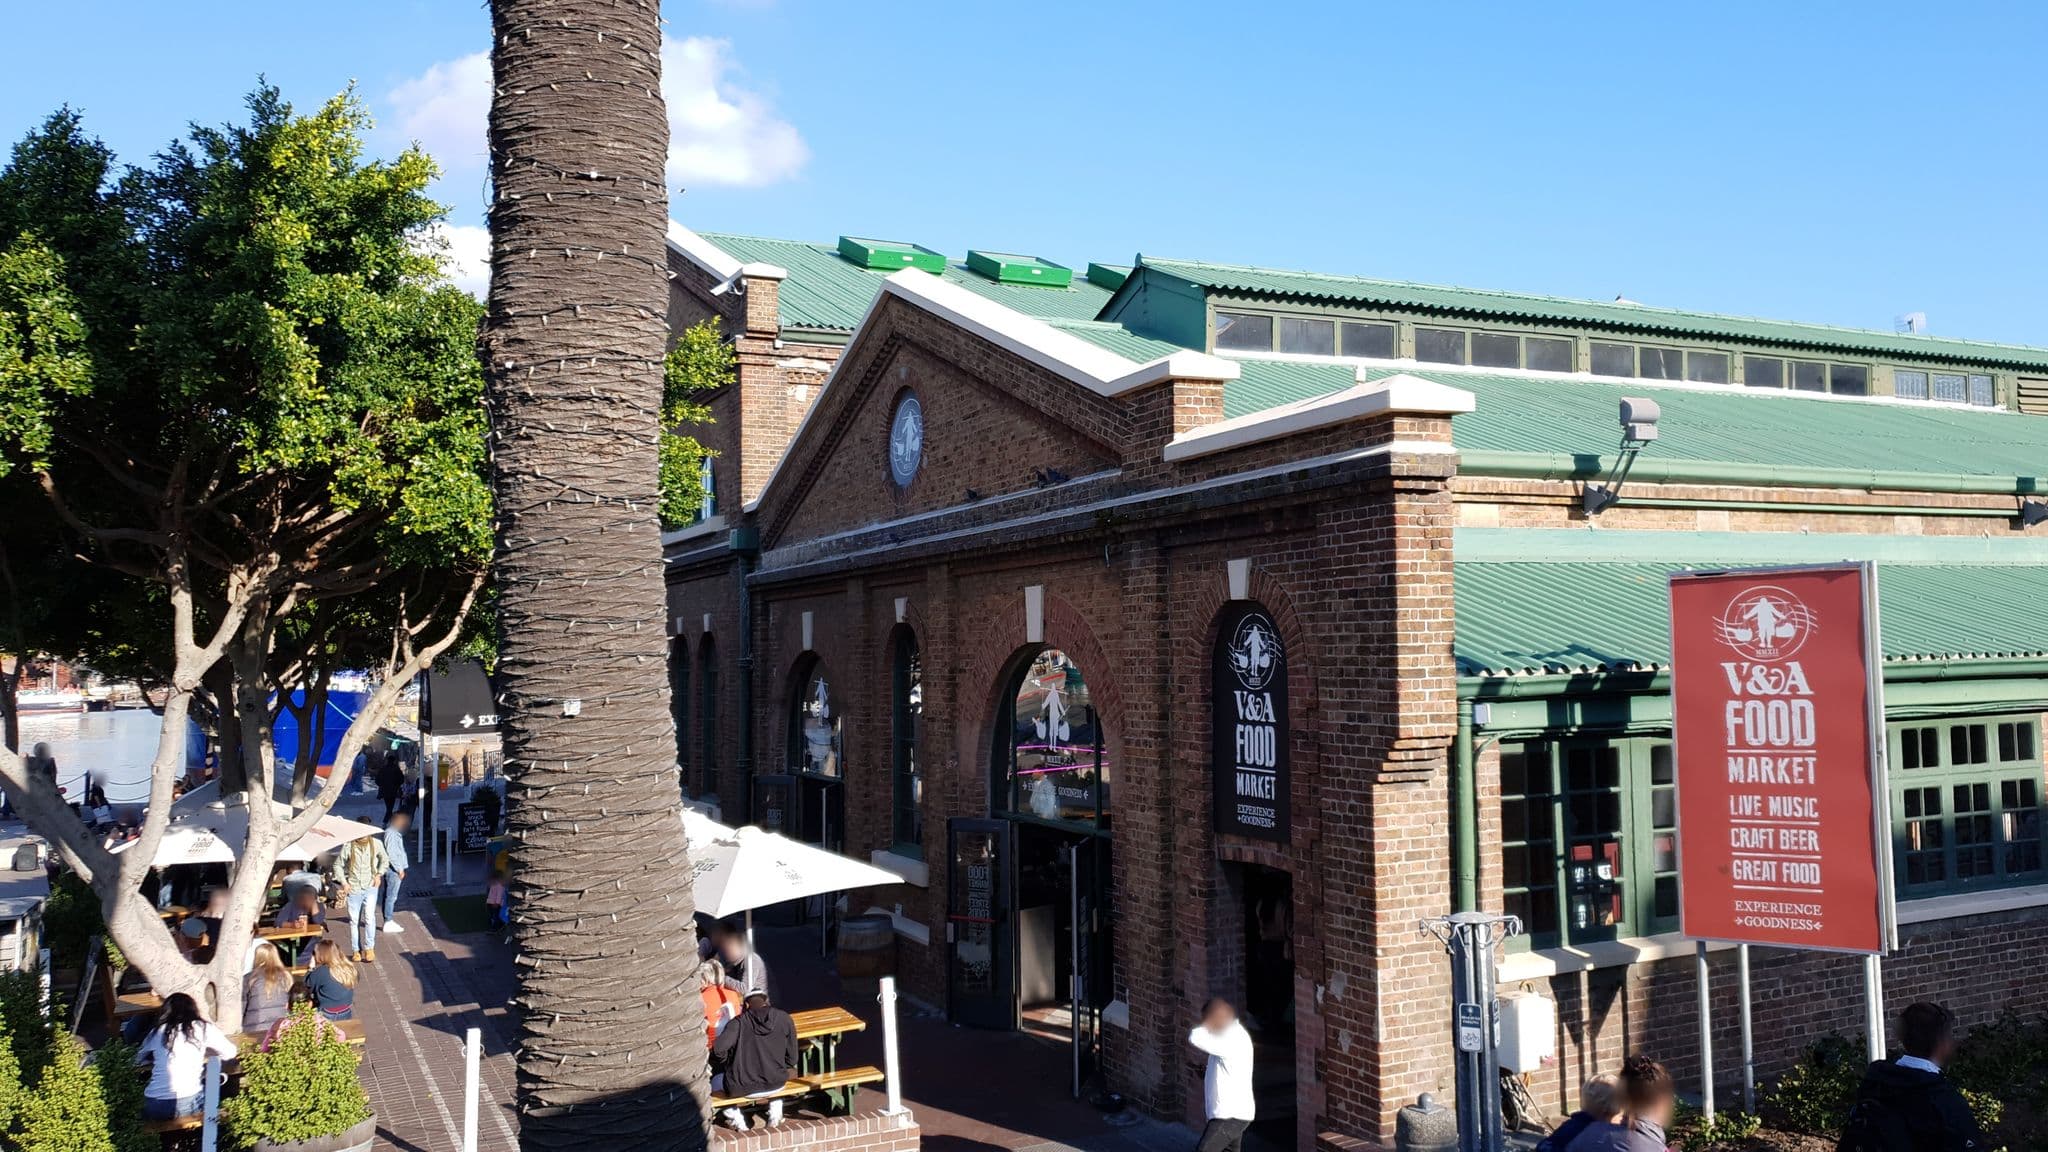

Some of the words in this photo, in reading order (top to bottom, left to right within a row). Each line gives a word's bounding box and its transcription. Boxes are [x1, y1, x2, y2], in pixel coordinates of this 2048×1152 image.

[1720, 661, 1814, 696] V&A
[1234, 690, 1276, 723] V&A
[1726, 699, 1815, 747] FOOD
[1236, 724, 1276, 768] FOOD
[1727, 756, 1817, 785] MARKET
[1236, 772, 1276, 800] MARKET
[1237, 803, 1276, 819] EXPERIENCE
[1729, 795, 1762, 817] LIVE
[1768, 796, 1819, 818] MUSIC
[1241, 815, 1272, 828] GOODNESS
[1730, 827, 1775, 850] CRAFT
[1780, 828, 1820, 852] BEER
[1733, 859, 1777, 882] GREAT
[1782, 861, 1821, 885] FOOD
[1734, 900, 1822, 917] EXPERIENCE
[1744, 915, 1813, 931] GOODNESS
